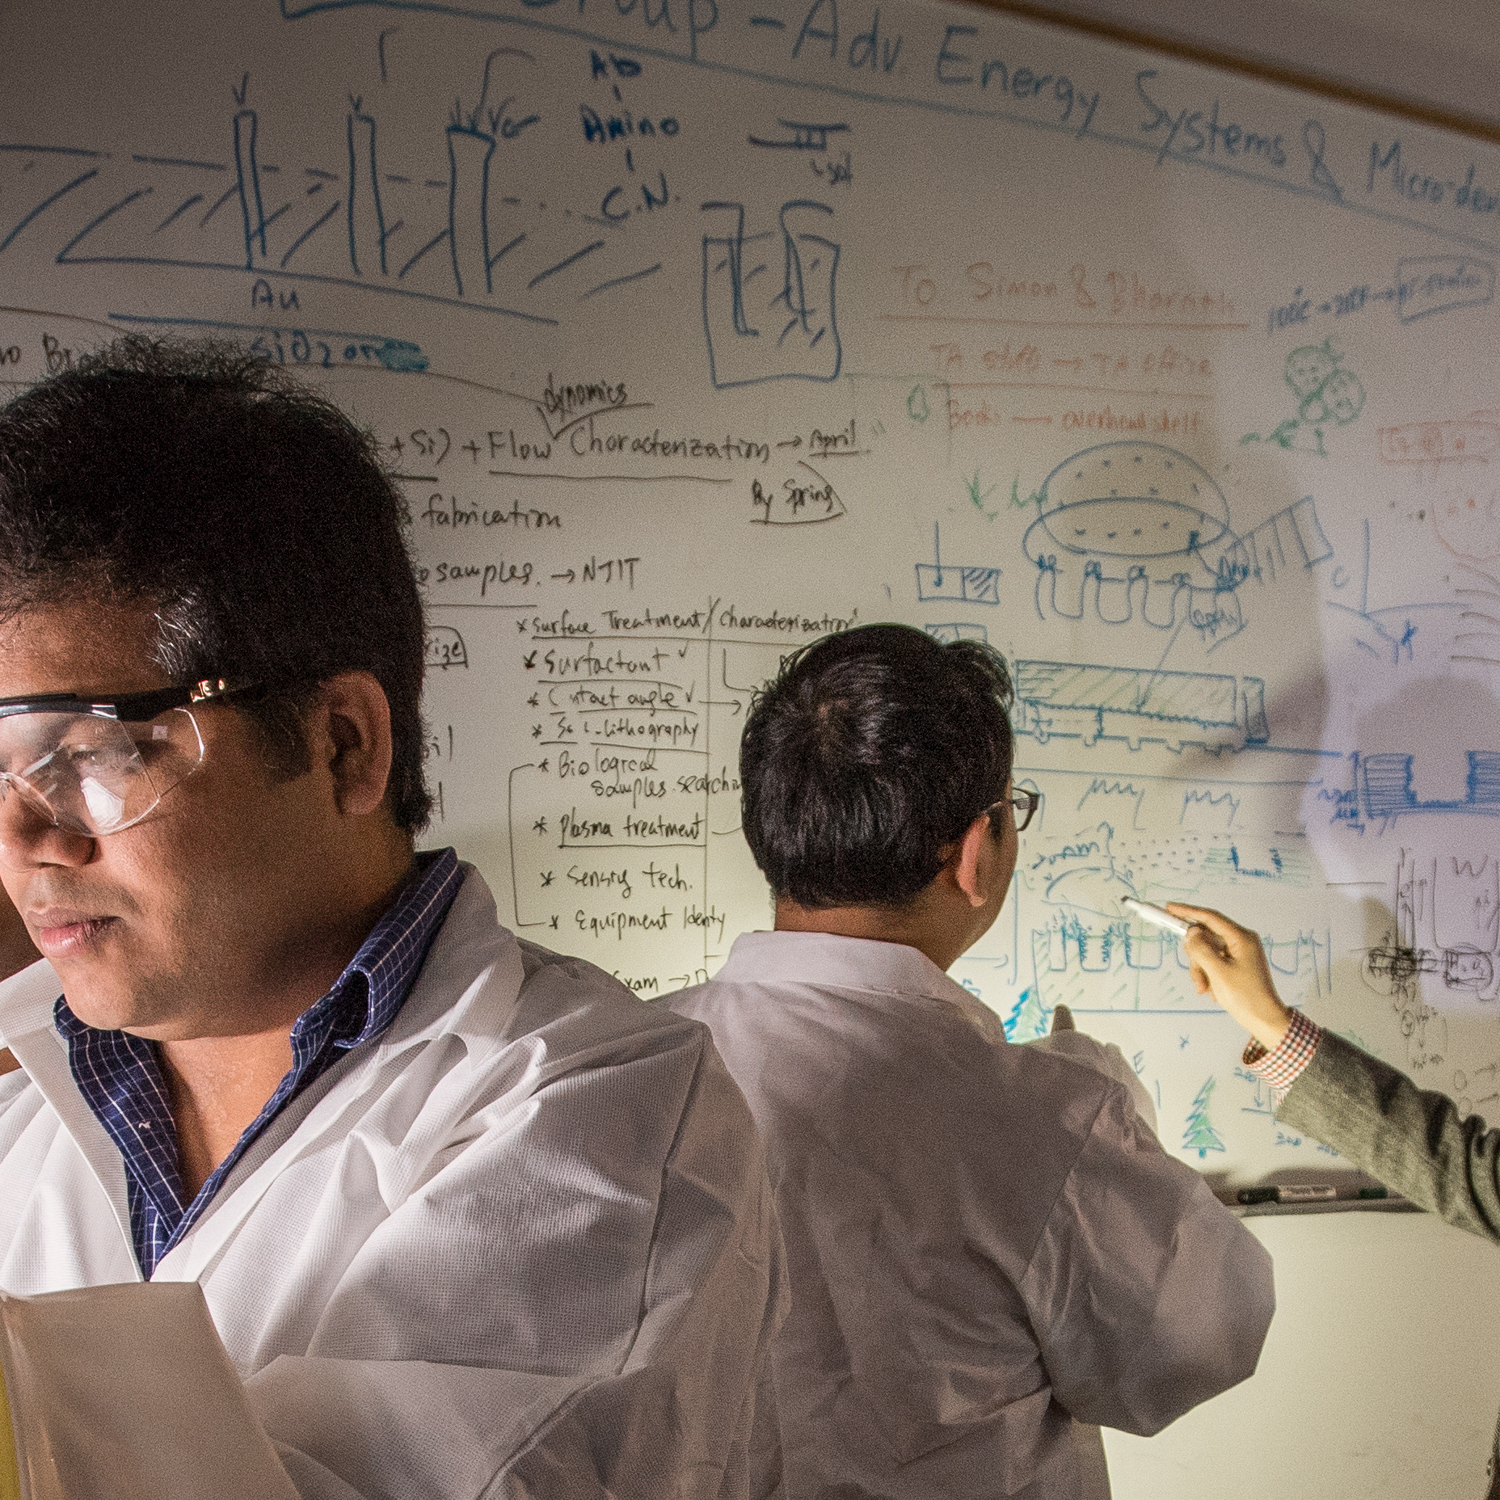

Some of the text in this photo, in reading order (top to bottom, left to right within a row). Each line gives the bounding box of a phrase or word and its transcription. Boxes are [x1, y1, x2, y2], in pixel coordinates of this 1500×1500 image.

[792, 0, 898, 72] Adv
[936, 25, 1099, 140] Energy
[1136, 69, 1286, 166] Systems
[1302, 120, 1343, 201] &
[581, 102, 680, 143] Amino
[252, 279, 300, 309] Au
[891, 263, 936, 306] To
[966, 260, 1057, 302] Simon
[1070, 262, 1096, 308] &
[488, 429, 552, 460] Flow
[809, 419, 855, 455] April
[421, 493, 561, 529] fabrication
[783, 478, 833, 514] Spring
[532, 609, 596, 636] Surface
[544, 641, 669, 676] Surfactant
[549, 682, 679, 716] Cntact angle
[558, 806, 705, 847] Plasma treatment
[575, 904, 673, 940] Equipment
